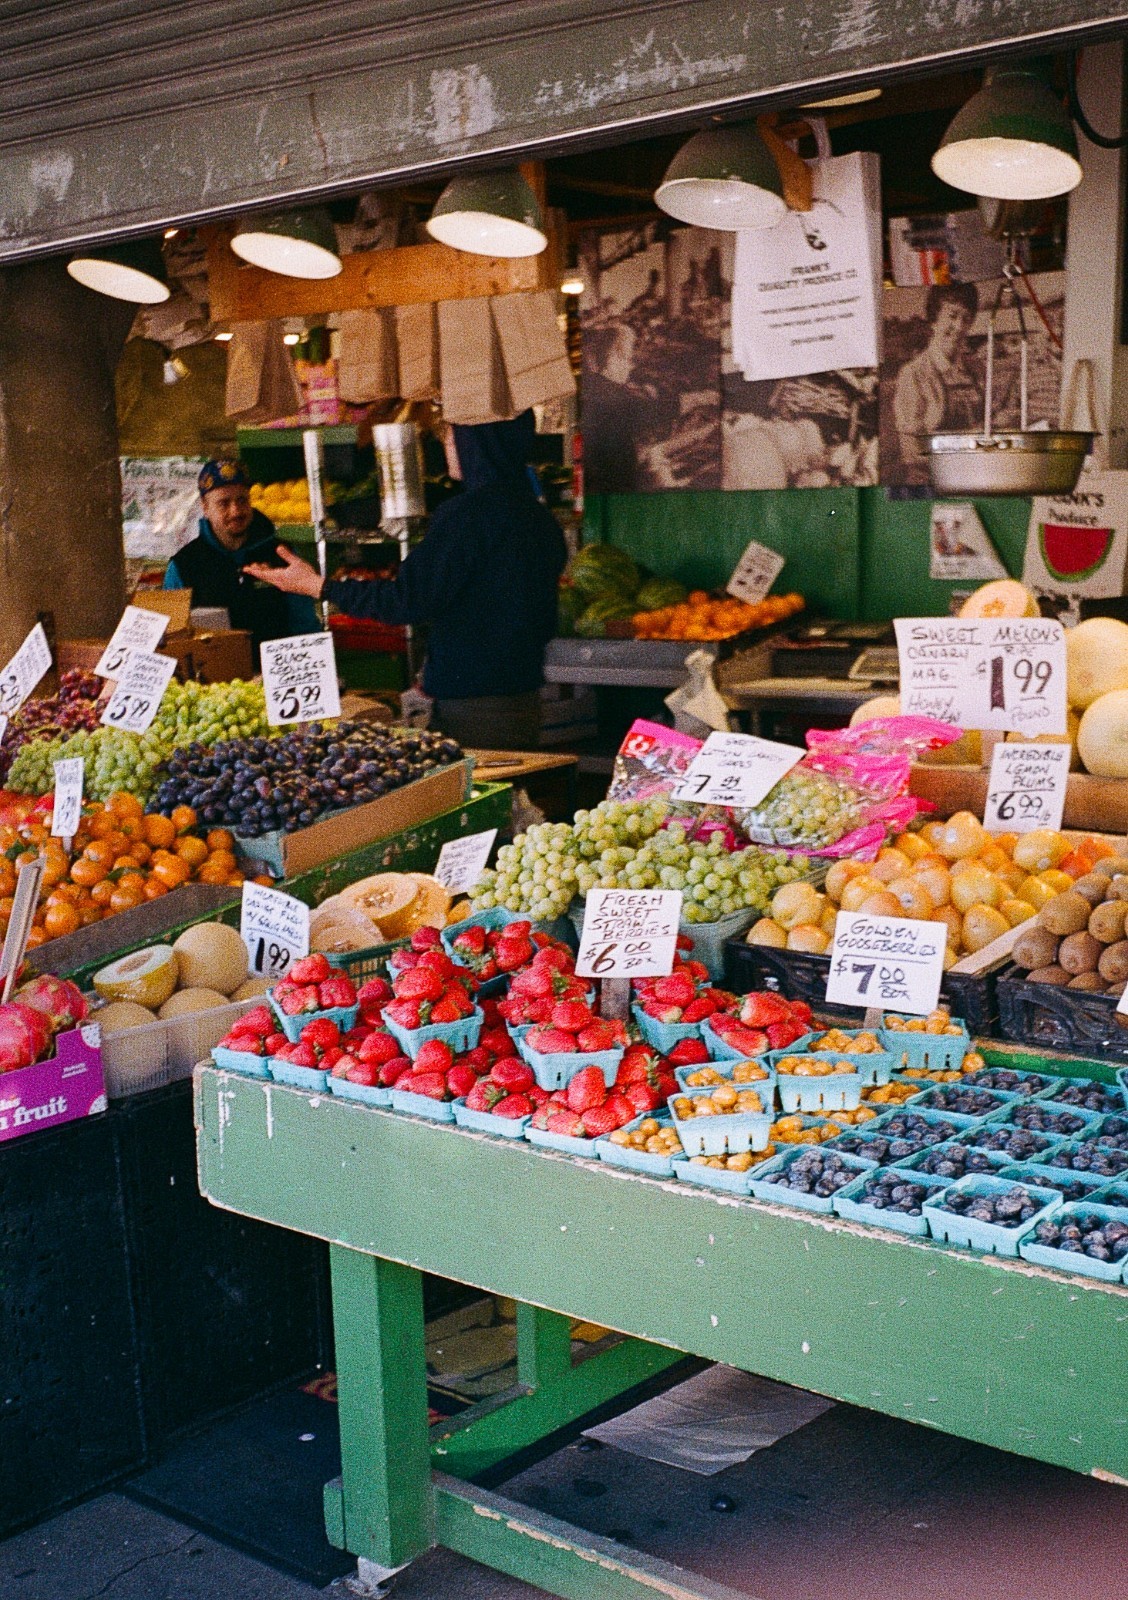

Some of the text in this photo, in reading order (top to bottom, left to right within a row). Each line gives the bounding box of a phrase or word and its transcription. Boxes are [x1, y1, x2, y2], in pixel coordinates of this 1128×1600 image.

[911, 625, 1061, 644] SWEET MELONS
[272, 651, 312, 666] BLACK
[907, 646, 969, 660] CANARY
[1005, 763, 1051, 775] LEMON
[1012, 775, 1056, 789] PLUMS
[600, 892, 663, 907] FRESH
[597, 906, 660, 920] SWEET
[602, 924, 671, 941] BERRIES
[849, 919, 920, 941] GOLDEN
[836, 933, 936, 957] GOOSEBERRIES
[623, 956, 657, 970] BOX
[880, 984, 911, 1000] BOX
[14, 1096, 67, 1126] fruit
